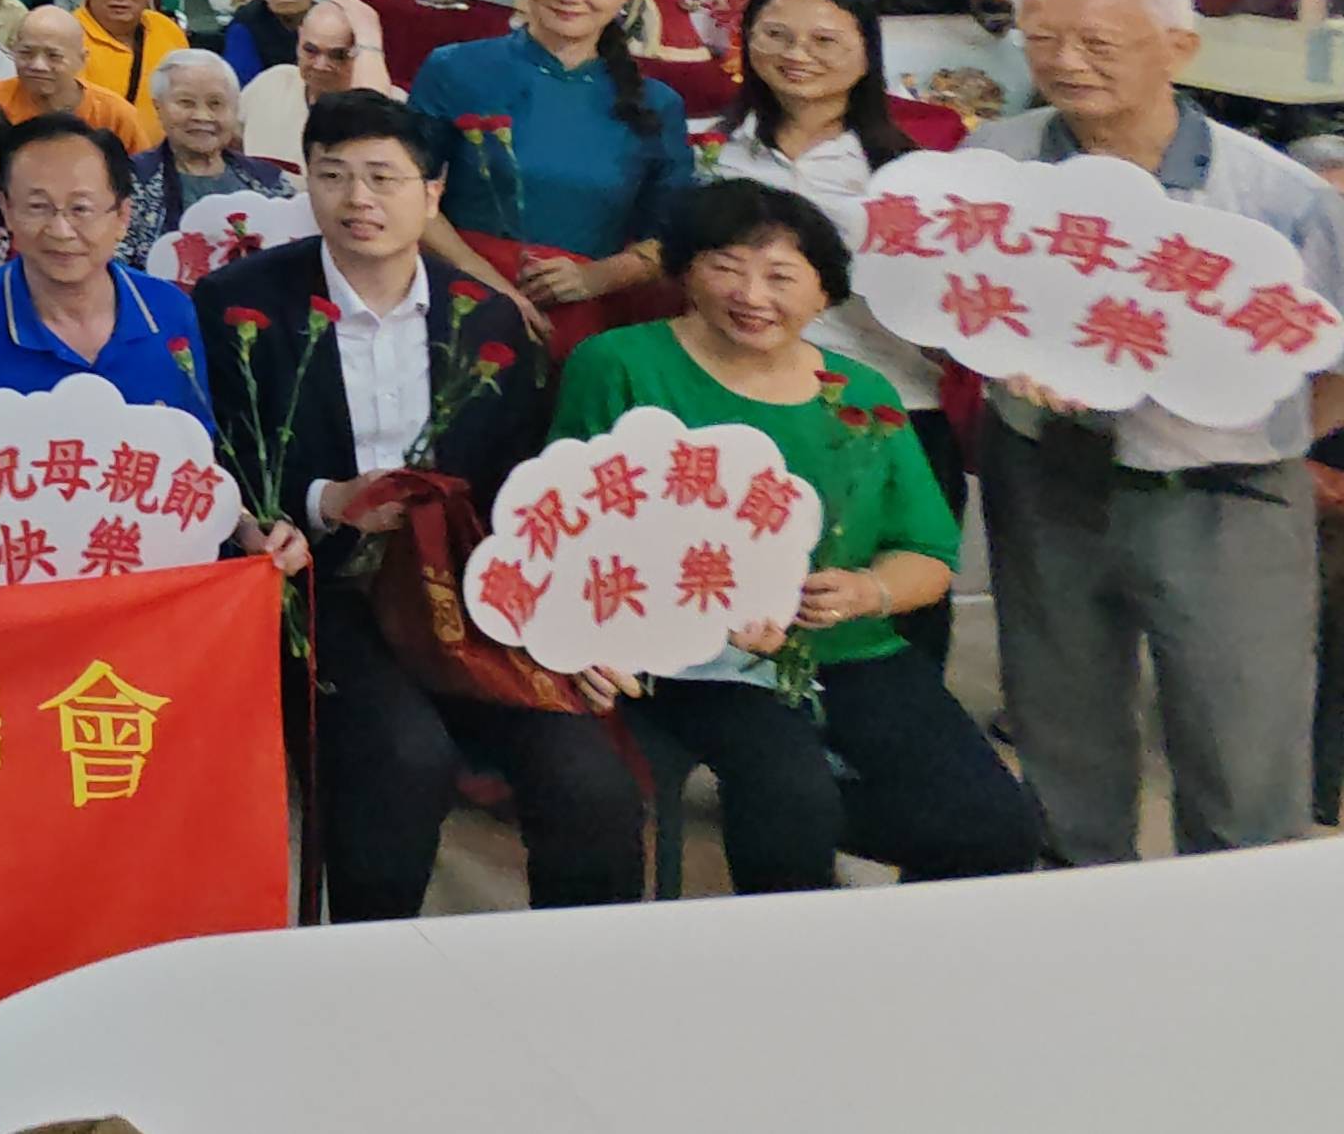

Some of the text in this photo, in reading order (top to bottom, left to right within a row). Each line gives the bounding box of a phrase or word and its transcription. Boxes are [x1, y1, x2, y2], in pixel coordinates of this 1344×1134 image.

[479, 438, 801, 637] 慶祝母親節
[582, 542, 737, 626] 快樂
